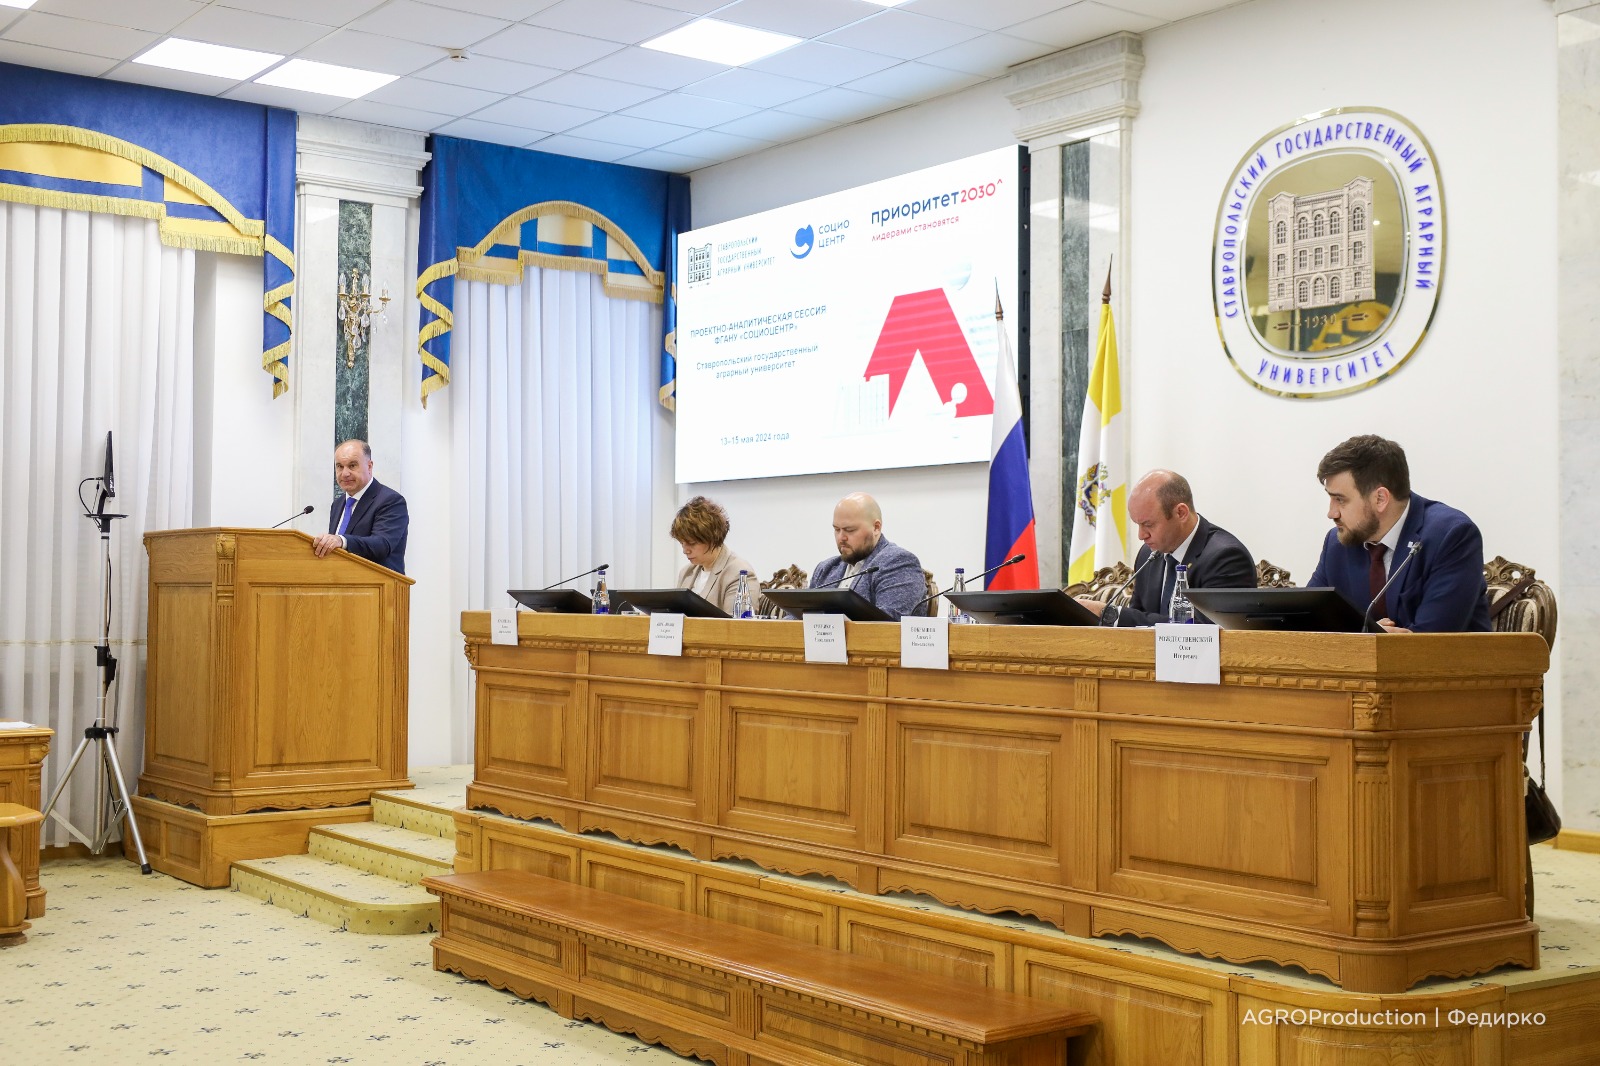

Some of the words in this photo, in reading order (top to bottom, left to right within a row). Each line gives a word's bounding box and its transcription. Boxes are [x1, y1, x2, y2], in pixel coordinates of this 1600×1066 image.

[818, 219, 850, 235] СОЦИО
[1222, 152, 1267, 318] СТАВРОПОЛЬСКИЙ
[1276, 122, 1426, 174] ГОСУДАРСТВЕННЫЙ
[1414, 184, 1435, 290] АГРАРНЫЙ
[871, 227, 912, 242] лидерами
[914, 216, 960, 232] становятся
[818, 234, 846, 249] ЦЕНТР
[690, 311, 793, 338] ПРОЕКТНО-АНАЛИТИЧЕСКАЯ
[794, 305, 827, 319] СЕССИЯ
[1305, 313, 1337, 329] 1930
[714, 333, 738, 345] ФГАНУ
[696, 354, 752, 370] Ставропольский
[753, 344, 819, 361] государственный
[1257, 341, 1396, 385] УНИВЕРСИТЕТ
[751, 360, 796, 375] университет
[755, 433, 771, 442] 2024
